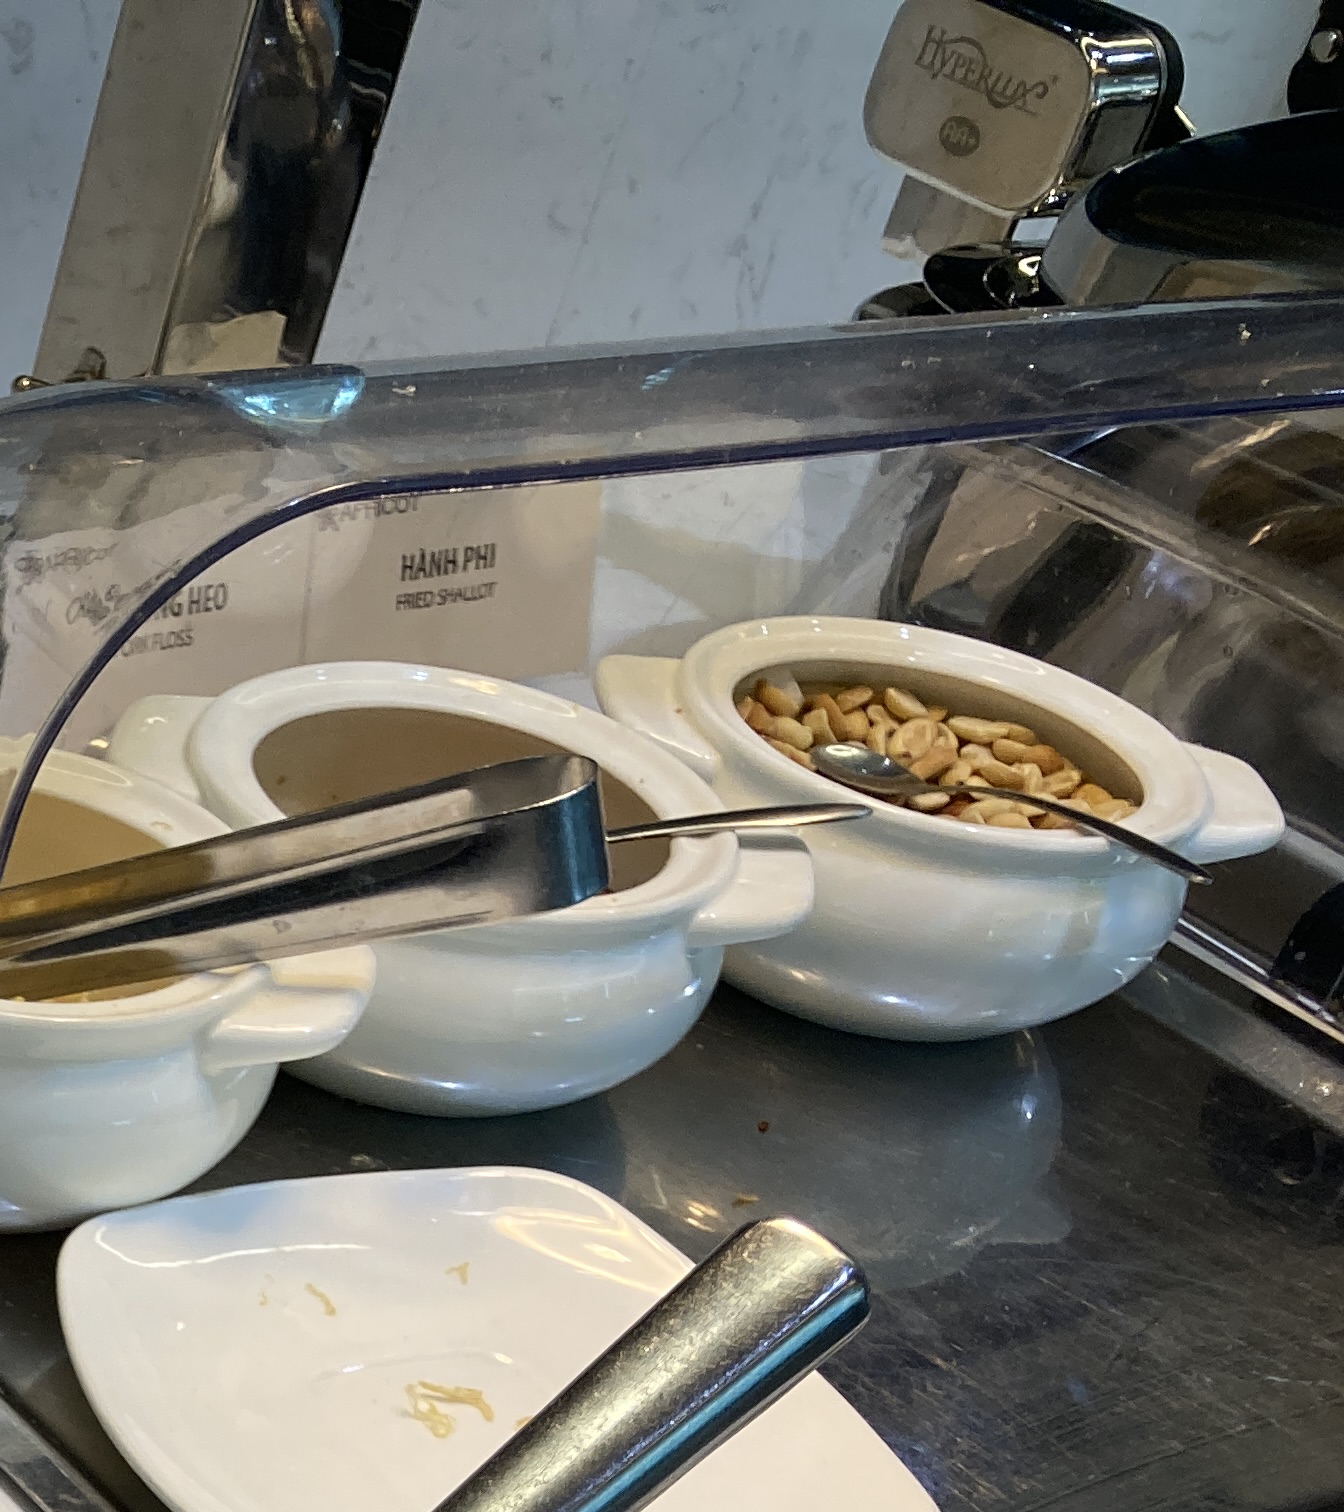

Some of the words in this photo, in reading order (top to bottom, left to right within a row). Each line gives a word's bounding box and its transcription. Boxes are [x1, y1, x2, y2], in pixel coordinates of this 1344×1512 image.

[400, 547, 460, 582] HÀNH
[462, 543, 496, 573] PHI
[187, 582, 229, 615] HEO
[395, 590, 434, 611] FRIED
